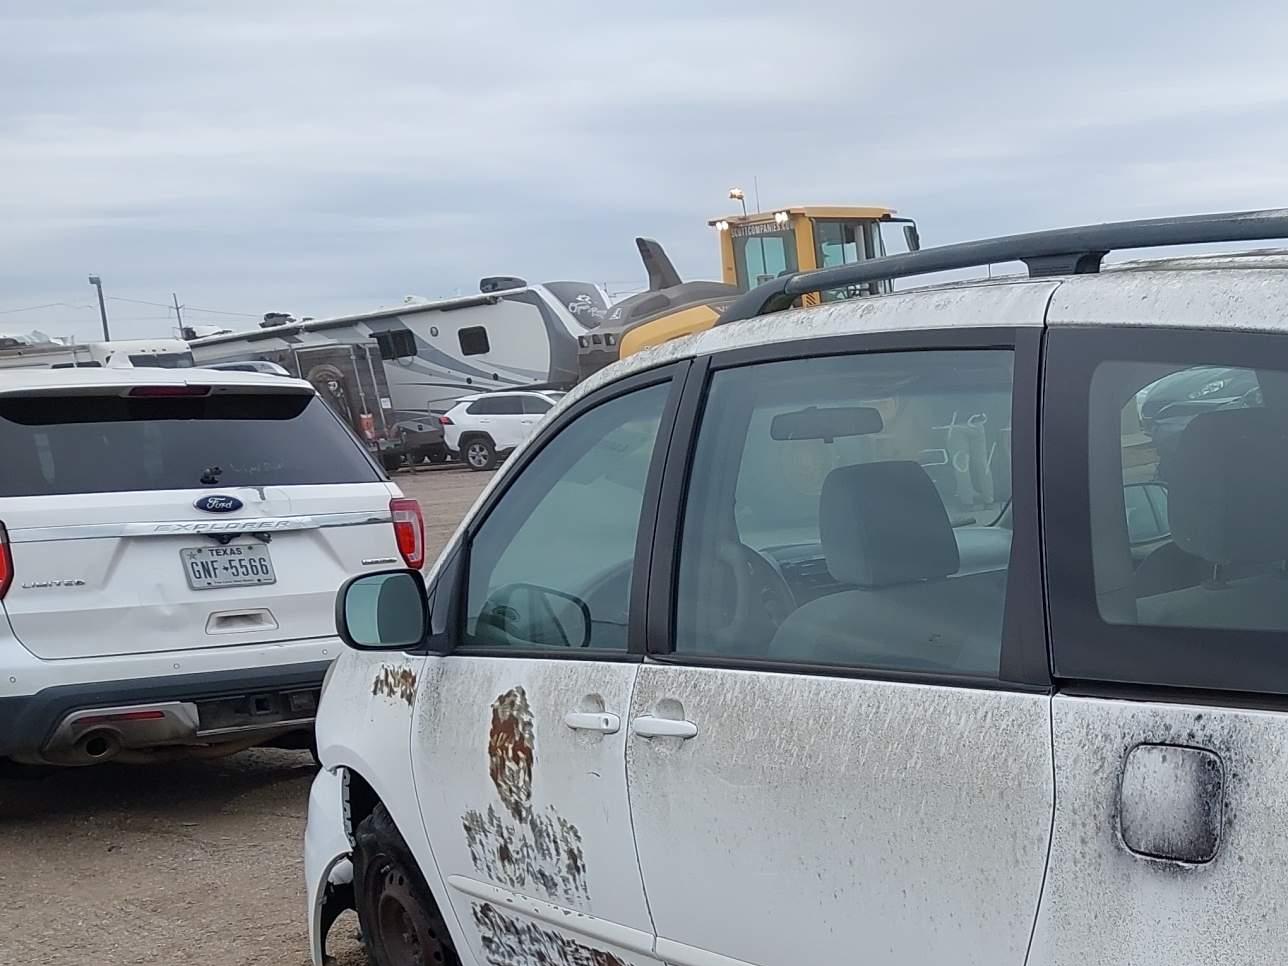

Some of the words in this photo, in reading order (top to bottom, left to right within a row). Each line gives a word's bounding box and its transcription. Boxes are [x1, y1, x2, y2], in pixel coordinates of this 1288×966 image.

[206, 497, 233, 509] Ford
[153, 520, 290, 533] EXPLORER
[208, 547, 242, 557] TEXAS
[190, 560, 218, 580] GNF
[228, 557, 270, 577] 5566
[22, 579, 86, 589] LIMITED
